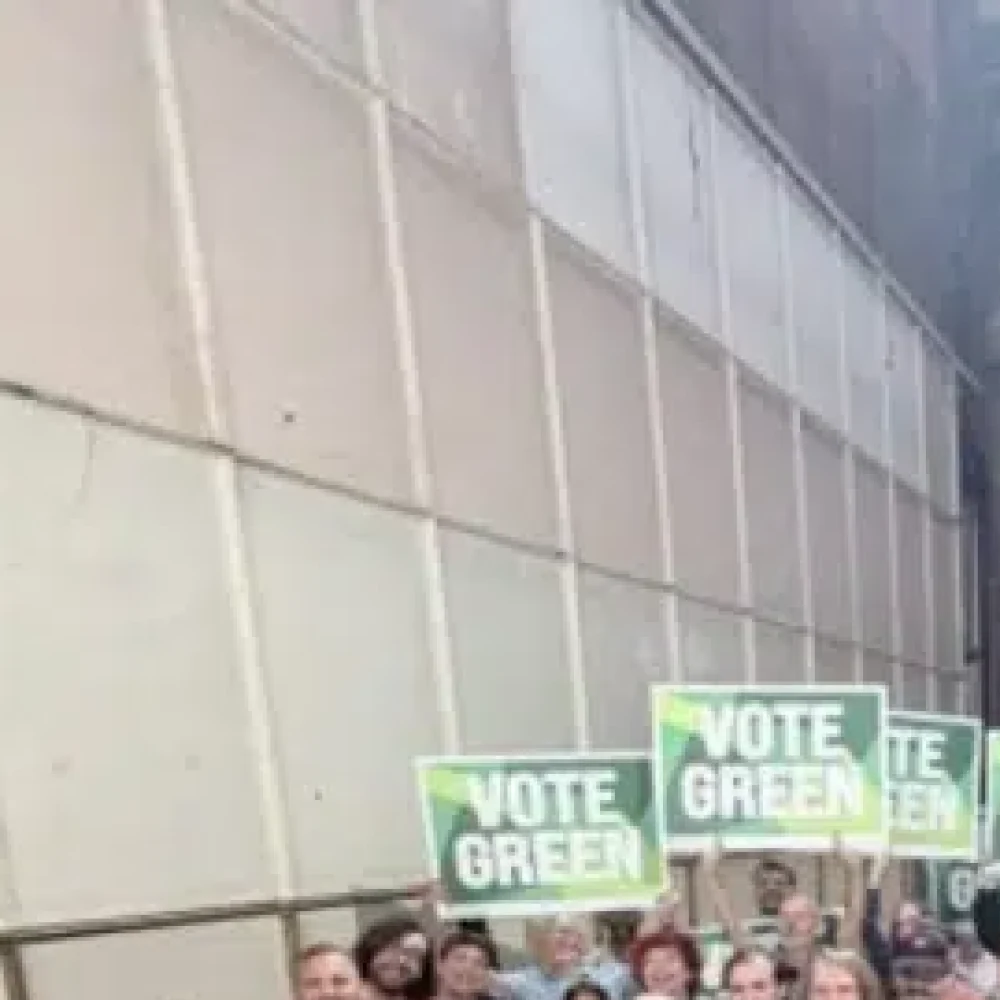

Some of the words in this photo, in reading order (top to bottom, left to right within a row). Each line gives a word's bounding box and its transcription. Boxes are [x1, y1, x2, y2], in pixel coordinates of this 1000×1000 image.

[702, 702, 843, 760] VOTE
[466, 768, 617, 828] VOTE
[682, 762, 865, 819] GREEN
[455, 833, 642, 889] GREEN
